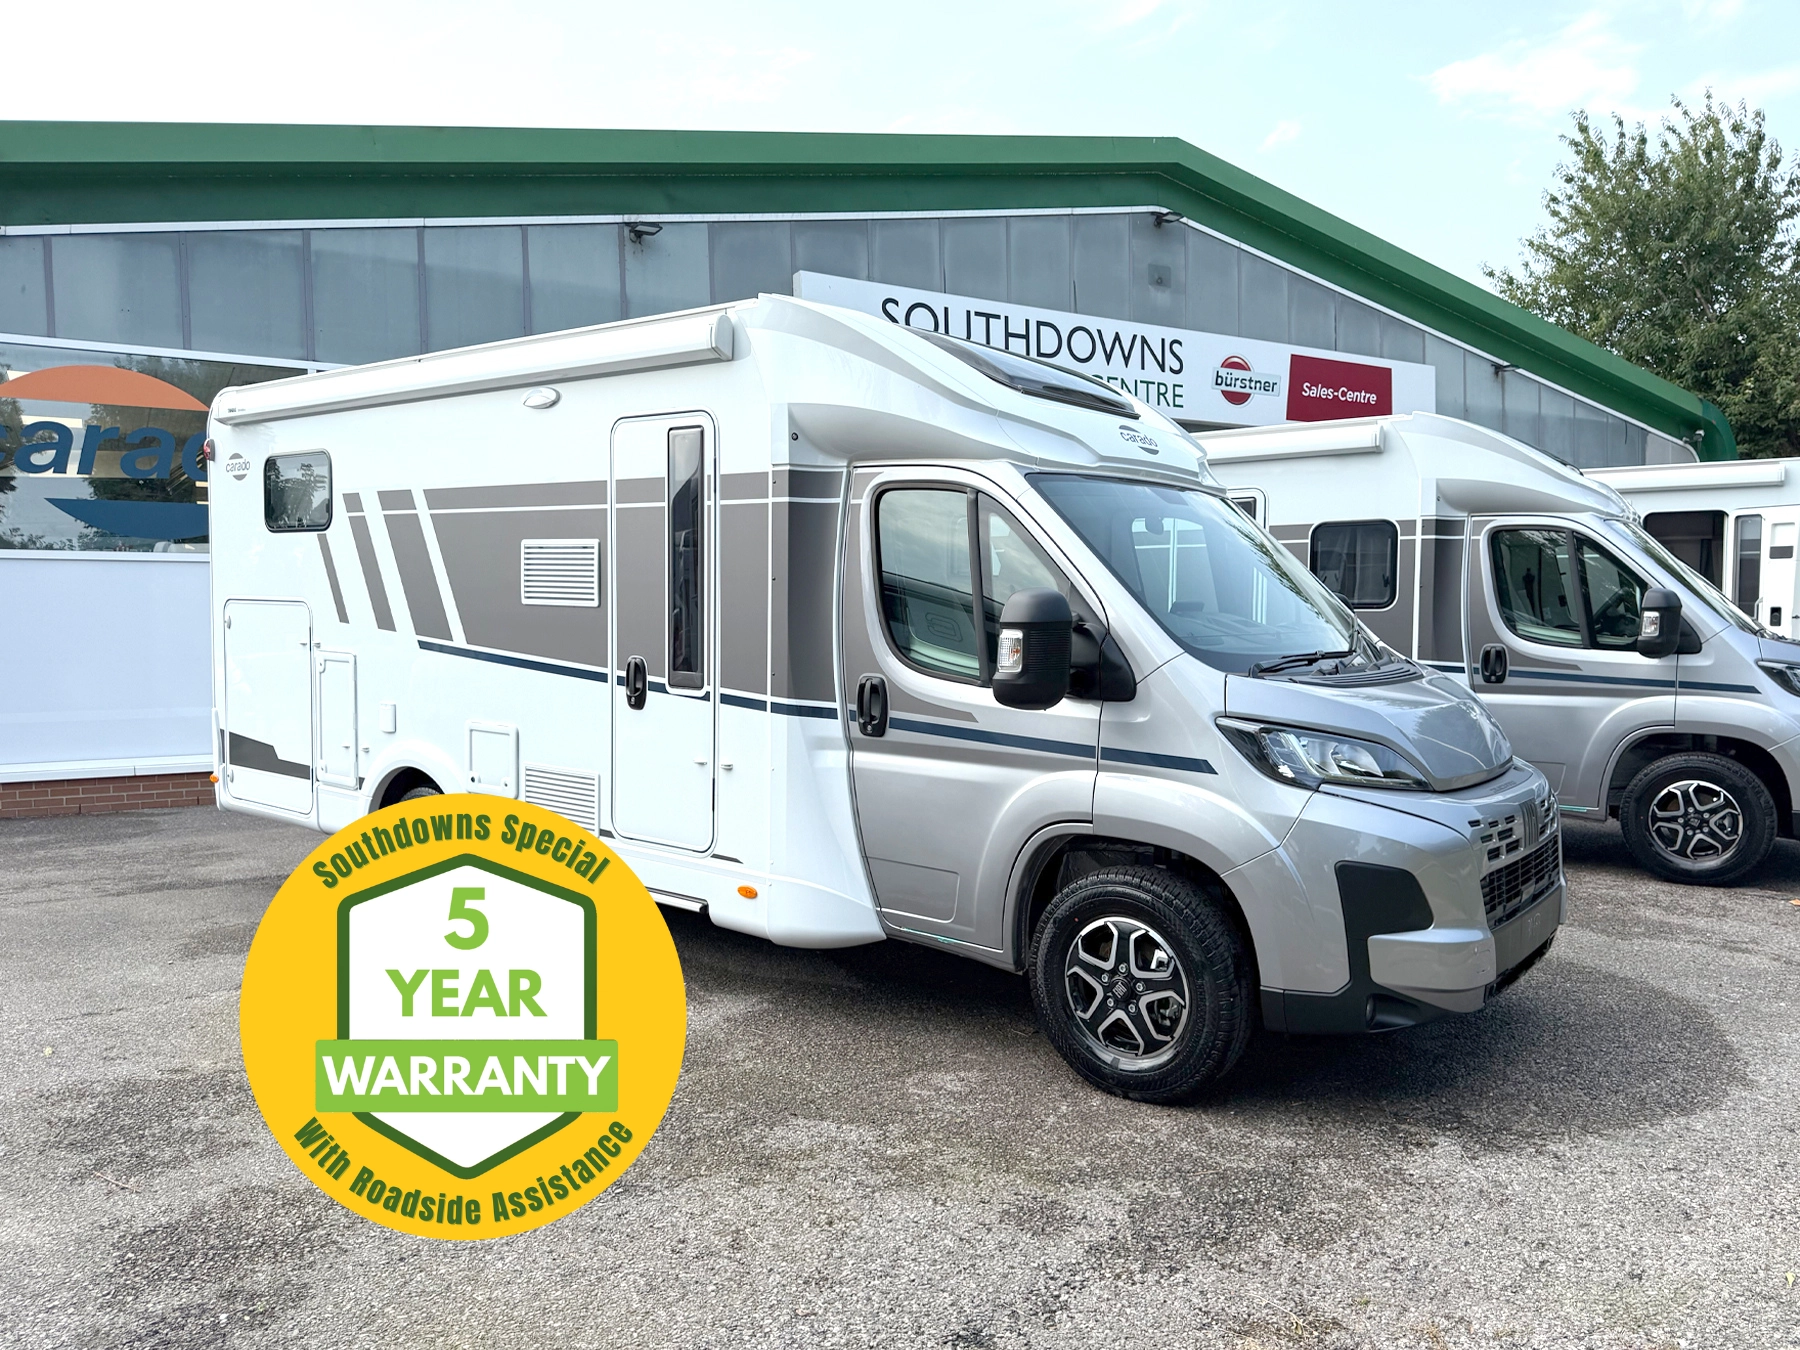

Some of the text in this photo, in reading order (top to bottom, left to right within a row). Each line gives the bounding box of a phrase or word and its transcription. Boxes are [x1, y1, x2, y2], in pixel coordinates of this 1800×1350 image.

[881, 297, 1184, 375] SOUTHDOWNS
[1214, 370, 1278, 393] bürstner
[1301, 382, 1378, 405] Sales-Centre
[1120, 432, 1158, 448] carado
[225, 459, 251, 473] carado
